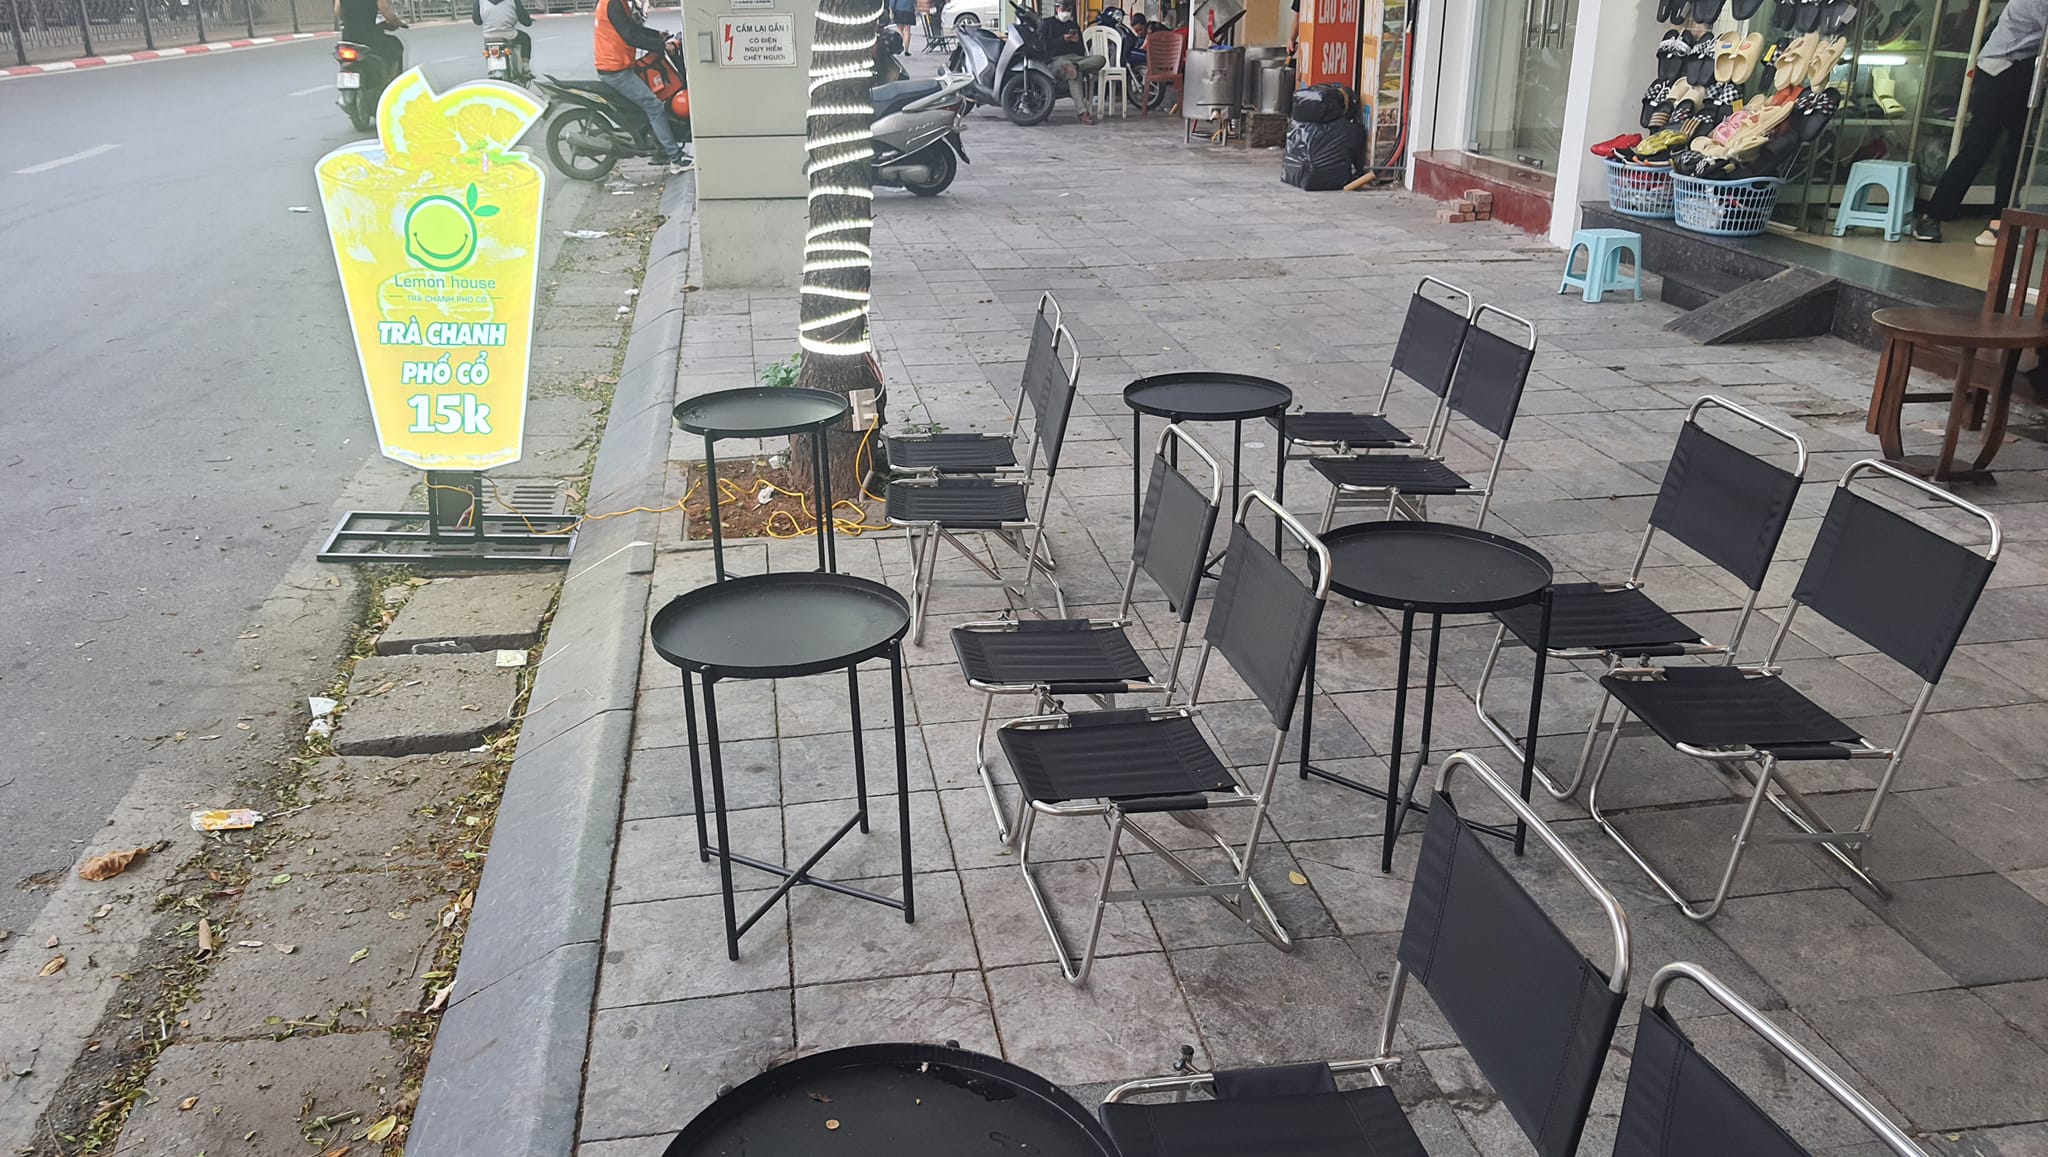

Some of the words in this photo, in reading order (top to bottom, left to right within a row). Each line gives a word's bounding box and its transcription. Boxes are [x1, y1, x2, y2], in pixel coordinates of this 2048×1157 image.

[1321, 41, 1348, 75] SAPA
[394, 274, 445, 288] Lemon
[450, 275, 496, 289] house
[424, 295, 454, 303] CHANH
[378, 315, 423, 345] TRÀ
[426, 321, 507, 346] CHANH
[401, 351, 452, 385] PHỐ
[456, 350, 490, 385] CỔ
[407, 393, 493, 434] 15k
